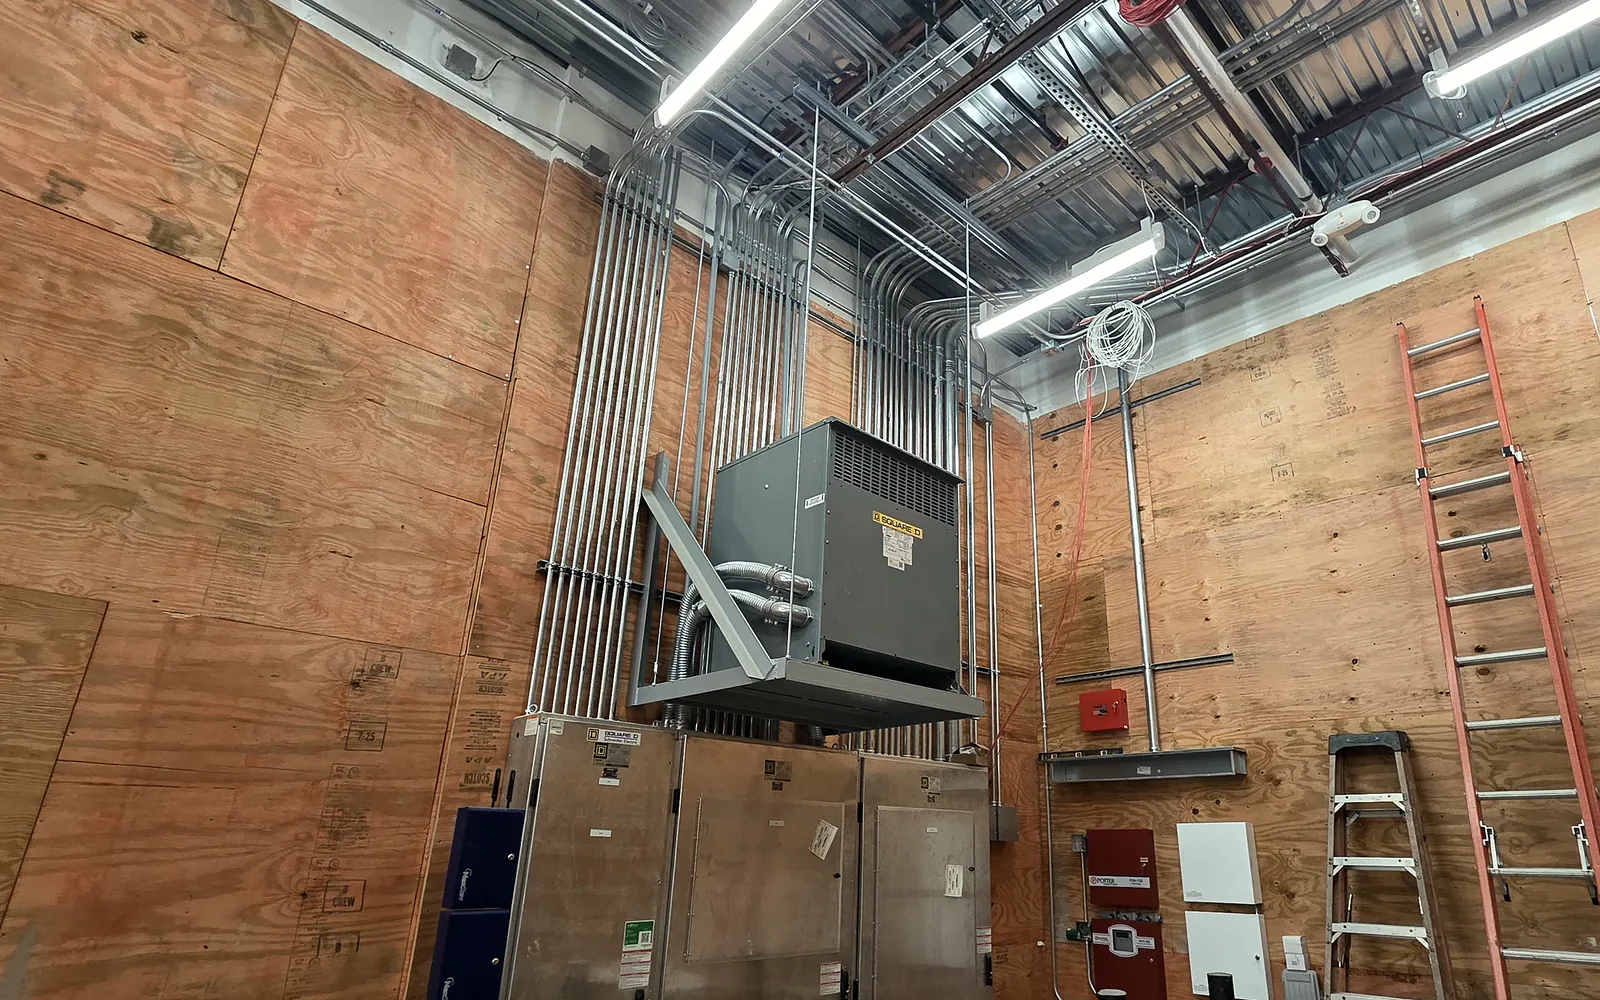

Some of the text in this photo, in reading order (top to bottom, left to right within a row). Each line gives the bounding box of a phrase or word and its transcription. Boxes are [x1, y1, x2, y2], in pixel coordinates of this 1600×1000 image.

[881, 516, 912, 533] SQUARE
[914, 528, 921, 536] D
[481, 671, 507, 680] APA
[478, 685, 504, 693] SCOTCH
[466, 756, 493, 764] APA
[463, 772, 491, 784] SCOTCH
[332, 896, 355, 908] CREW
